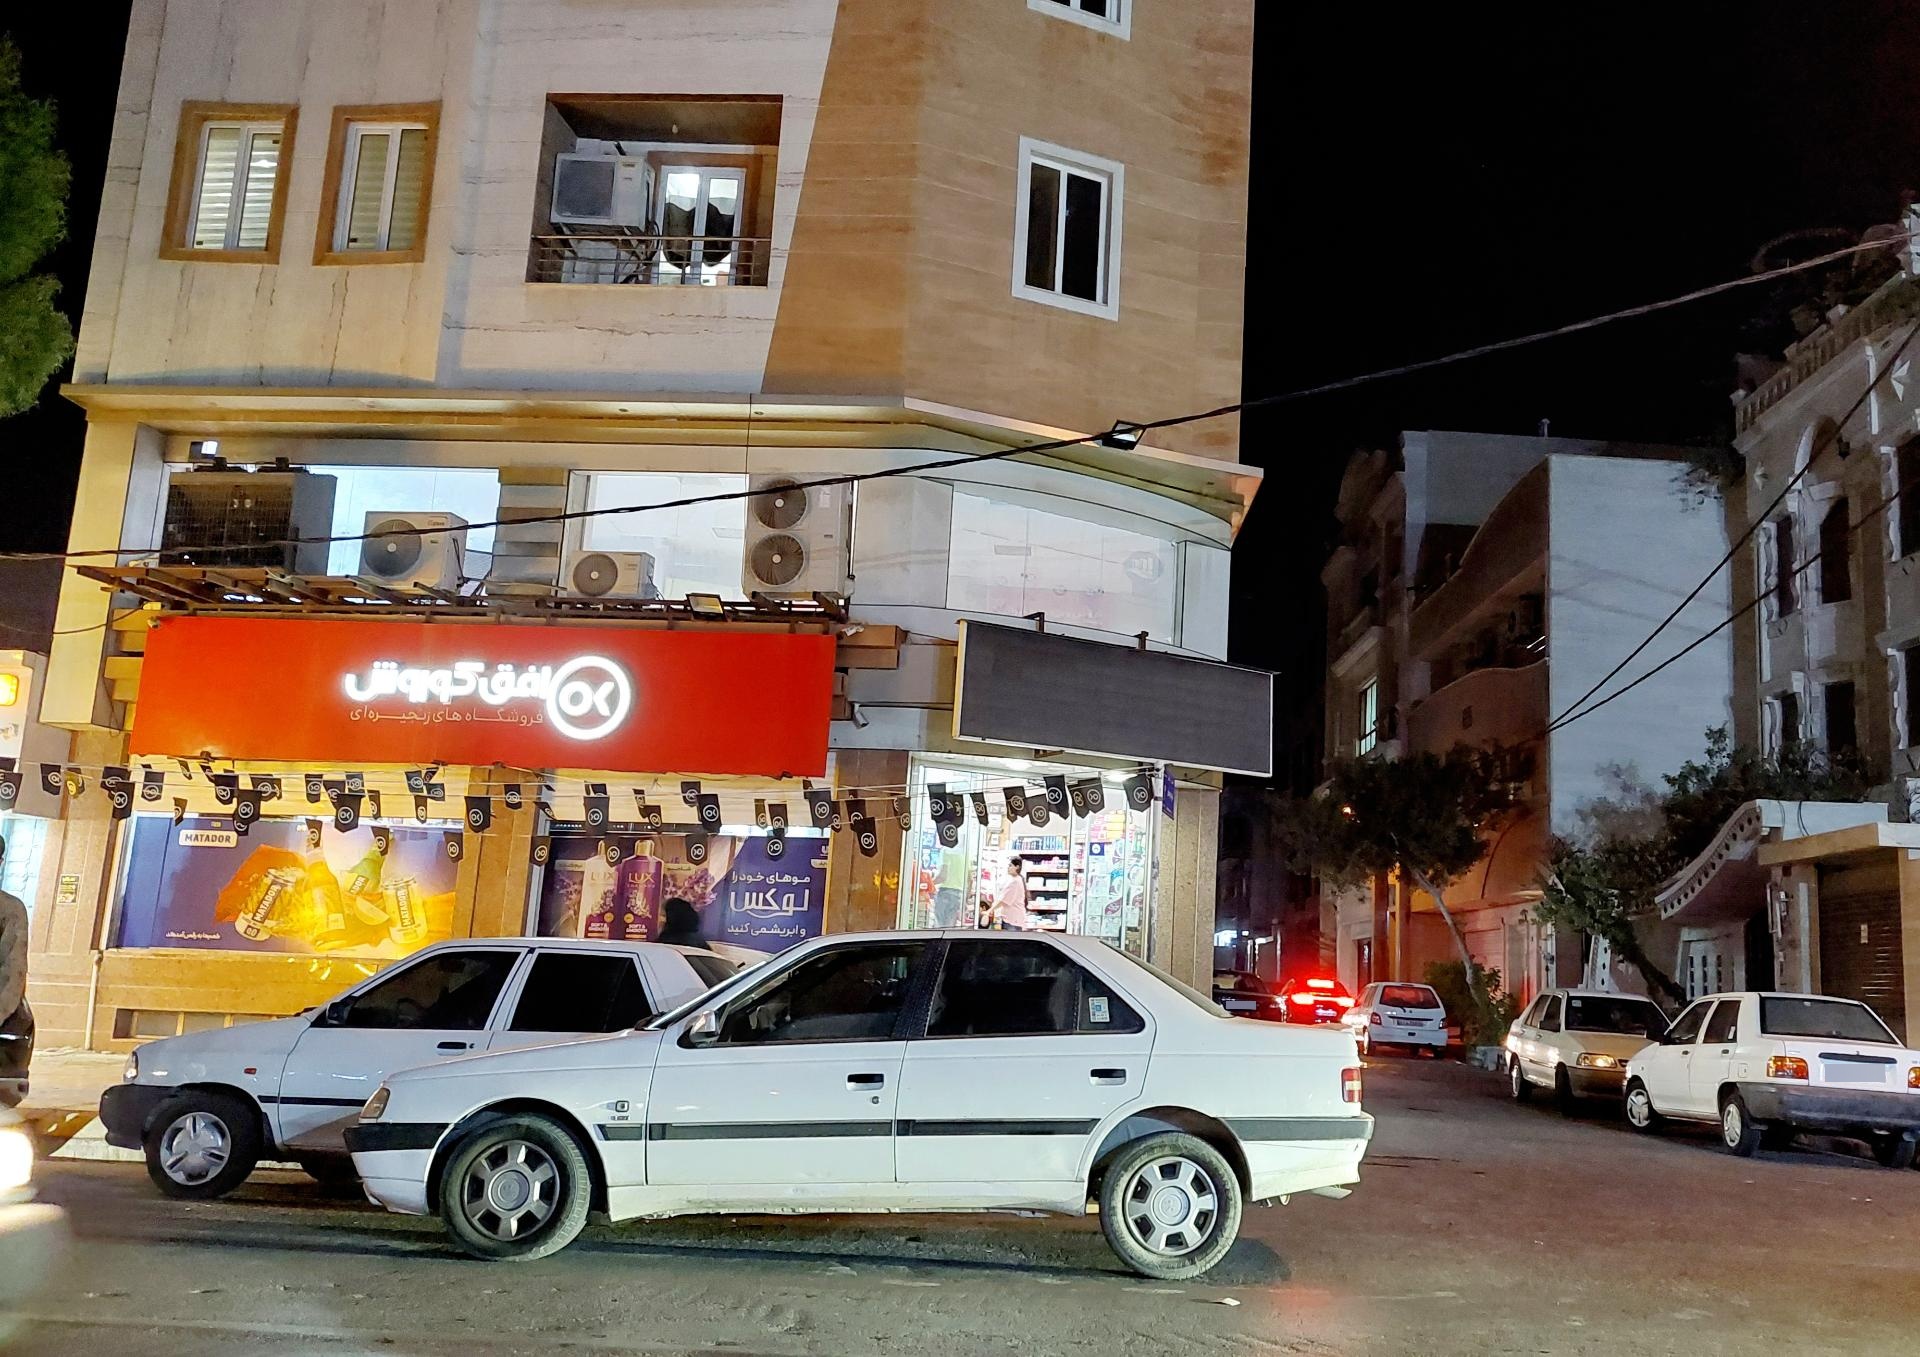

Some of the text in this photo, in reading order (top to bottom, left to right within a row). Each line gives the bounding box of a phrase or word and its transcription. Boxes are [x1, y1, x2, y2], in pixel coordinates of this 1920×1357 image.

[345, 661, 552, 705] افق کوروش
[432, 707, 462, 723] های
[465, 708, 544, 727] فروشگاه
[184, 833, 231, 844] MATADOR
[628, 872, 655, 884] LUX
[731, 870, 811, 886] موهای خود را
[253, 885, 282, 922] MATADOR
[729, 887, 810, 919] لوکس
[727, 922, 750, 934] کنید
[750, 923, 799, 938] ابریشمی
